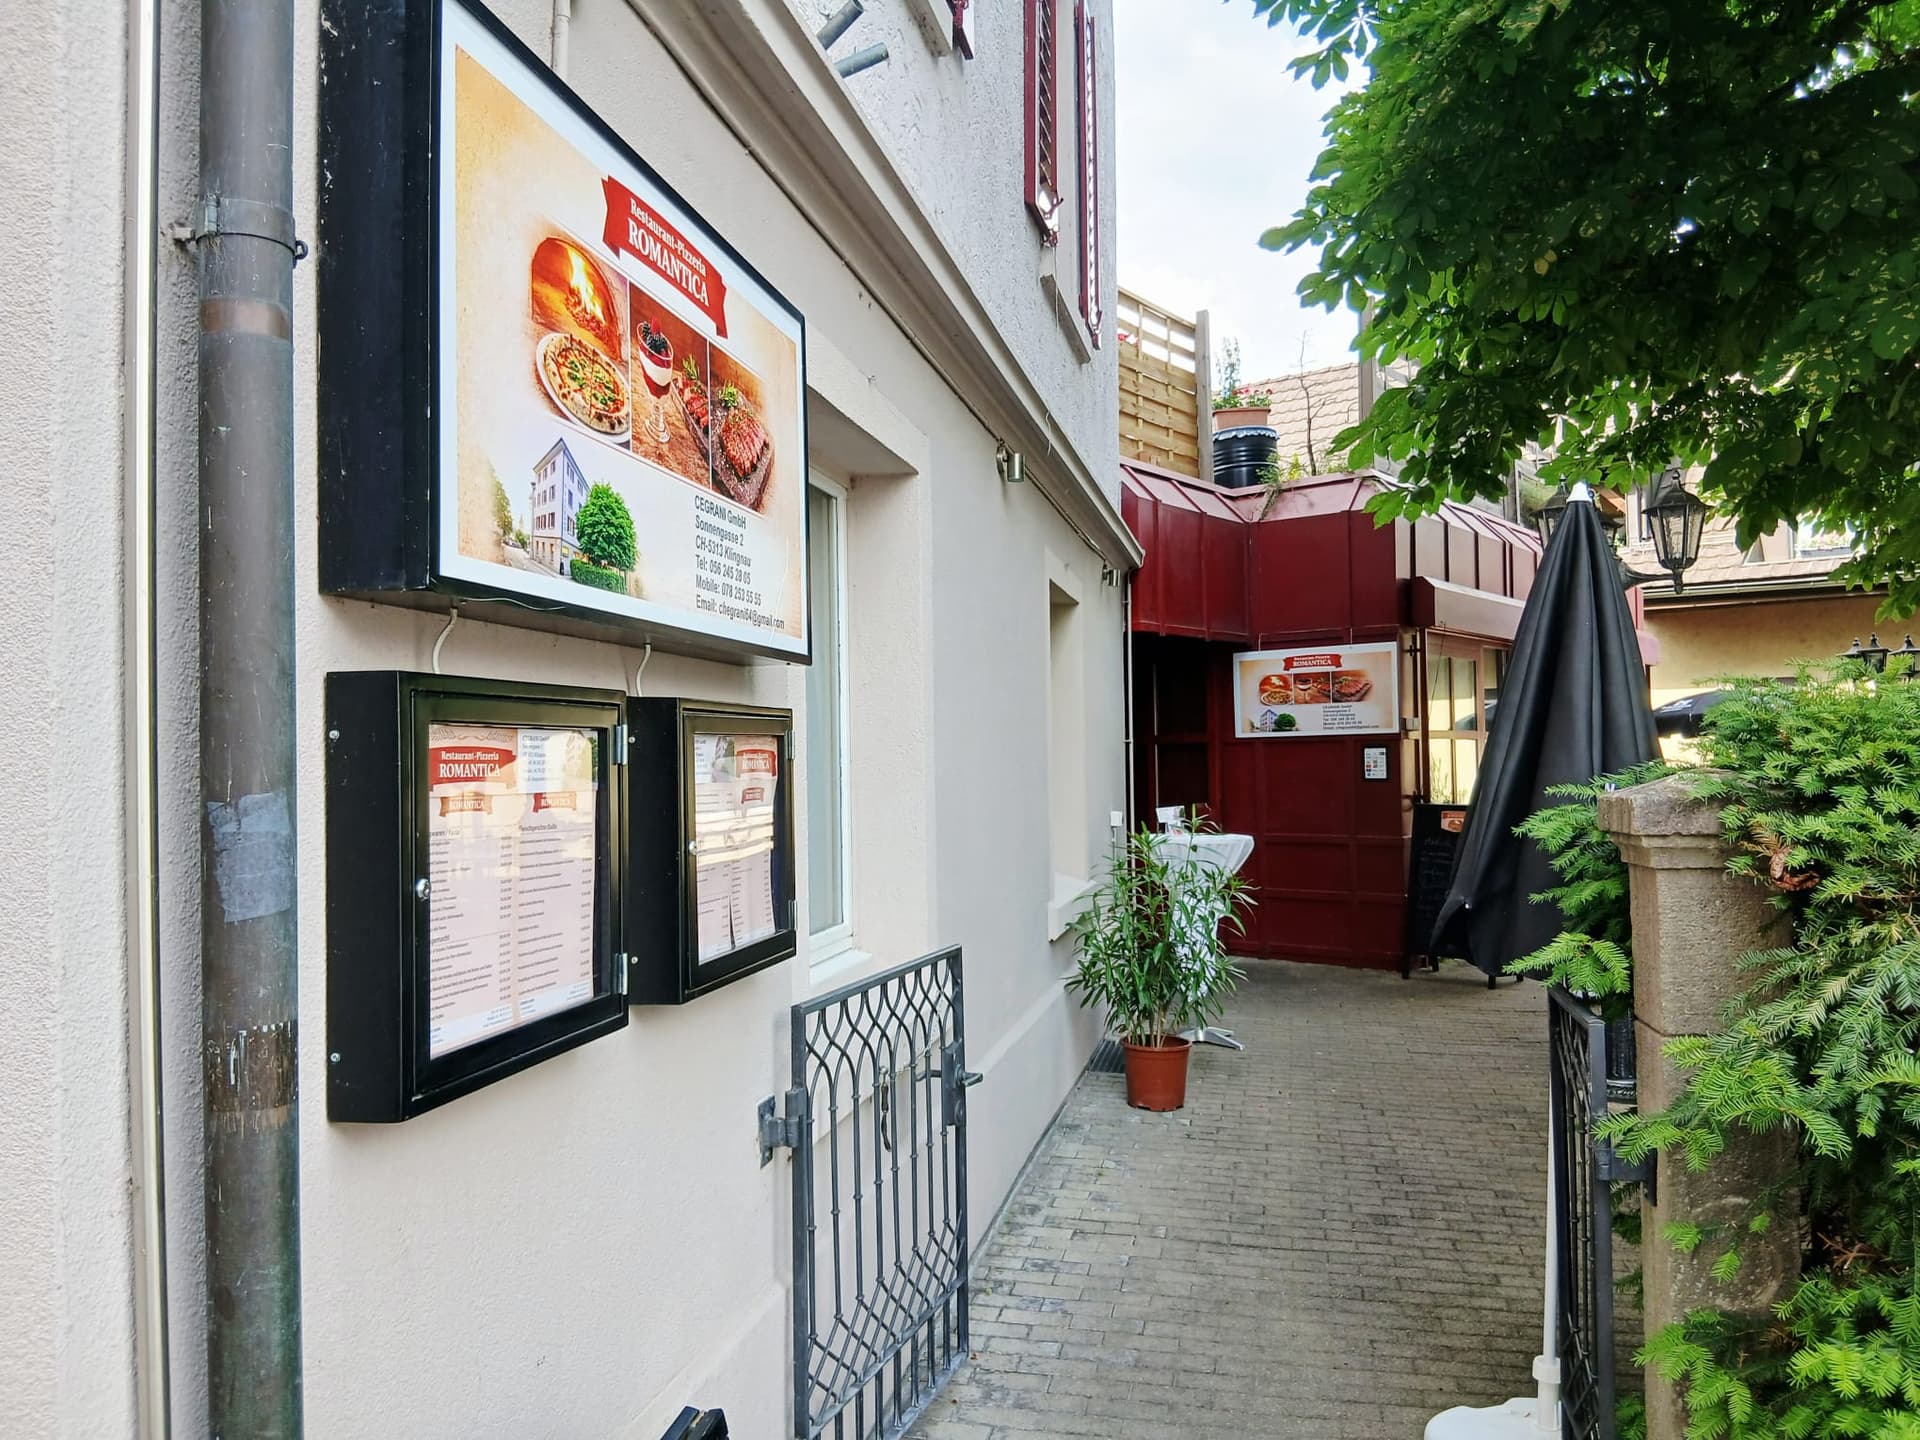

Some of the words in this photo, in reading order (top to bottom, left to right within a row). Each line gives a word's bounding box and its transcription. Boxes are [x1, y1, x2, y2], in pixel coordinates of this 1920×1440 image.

[630, 198, 706, 276] Restaurant-Pizzeria
[628, 218, 709, 307] ROMANTICA
[695, 495, 726, 520] CEGRANI
[727, 510, 746, 529] GmbH
[695, 515, 739, 544] Sonnengasse
[695, 535, 723, 557] CH-5313
[724, 546, 752, 567] Klingnau
[695, 554, 708, 571] Tel:
[722, 564, 734, 579] 245
[695, 574, 720, 594] Mobile:
[721, 582, 733, 598] 078
[734, 587, 745, 601] 253
[696, 594, 717, 613] Email:
[441, 751, 499, 761] Restaurant-Pizzeria
[439, 763, 501, 778] ROMANTICA
